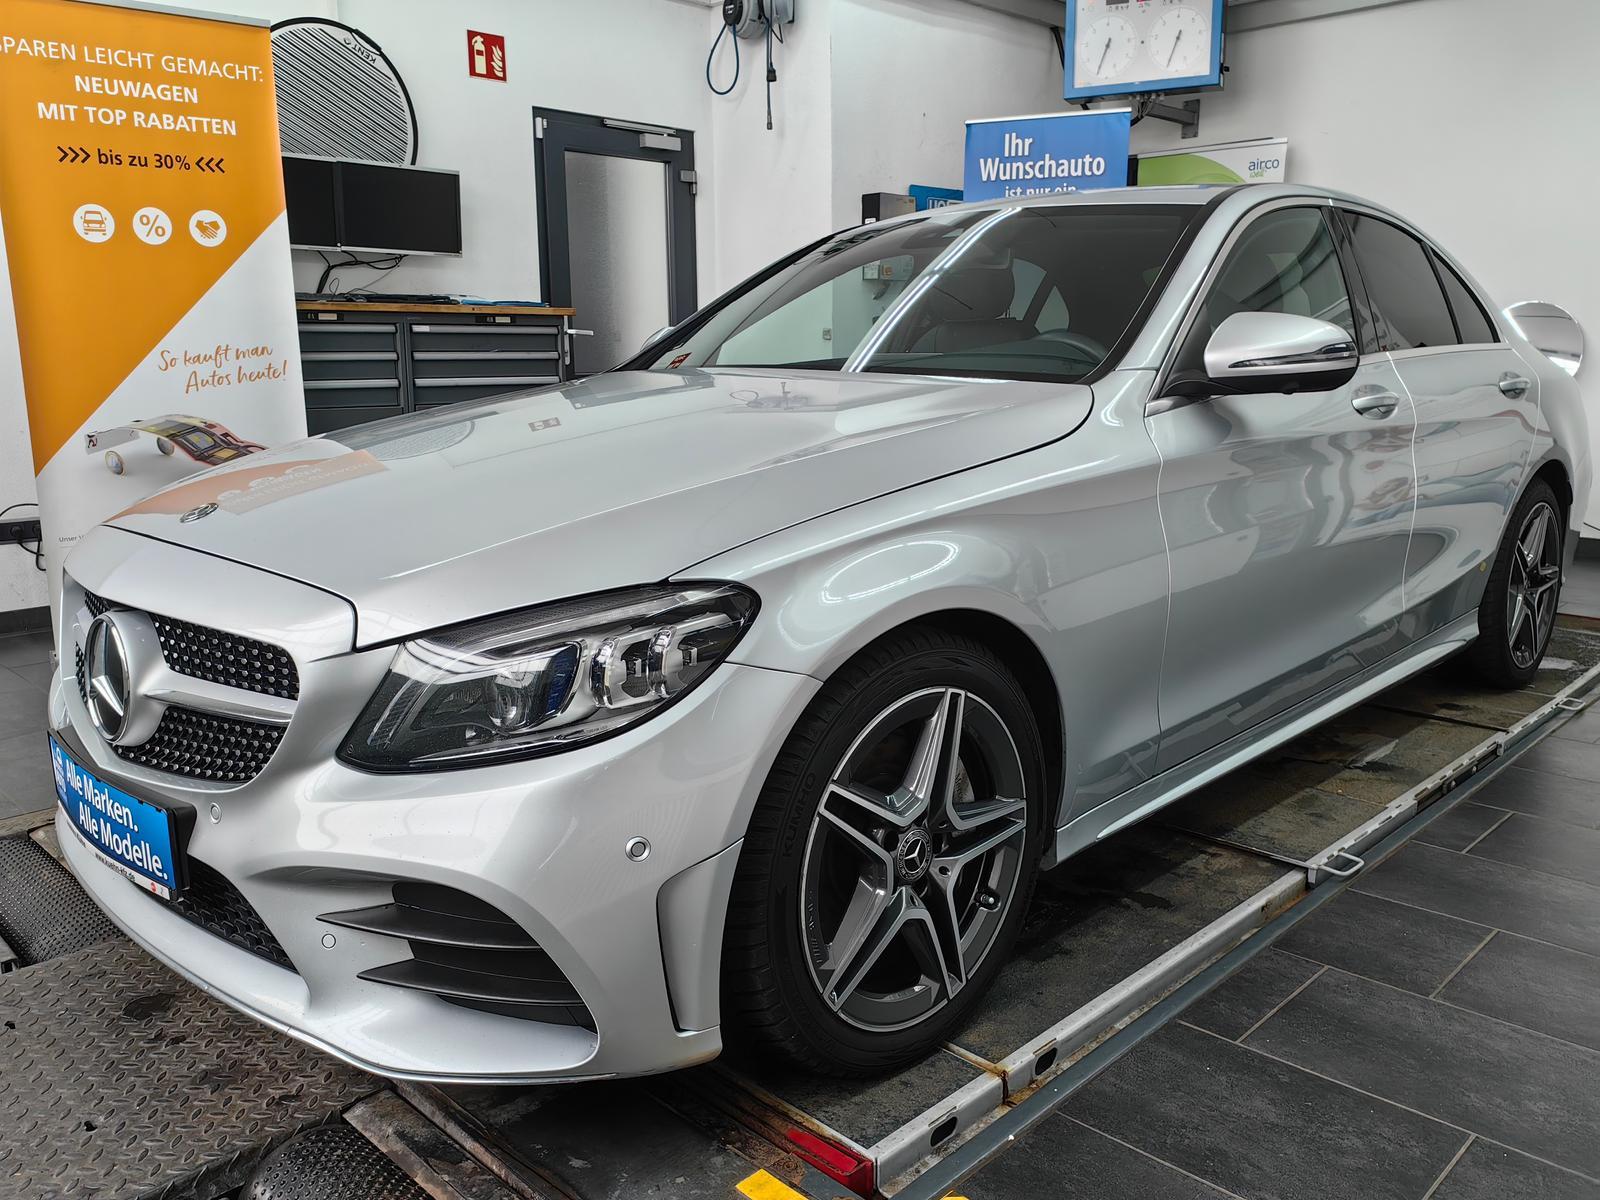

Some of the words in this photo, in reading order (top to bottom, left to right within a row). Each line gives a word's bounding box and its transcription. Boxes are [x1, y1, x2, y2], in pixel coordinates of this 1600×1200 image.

[84, 46, 154, 69] LEICHT
[161, 55, 264, 82] GEMACHT:
[352, 44, 377, 64] KENT
[75, 75, 198, 103] NEUWAGEN
[37, 102, 77, 121] MIT
[84, 106, 127, 126] TOP
[134, 112, 237, 136] RABATTEN
[1003, 132, 1034, 158] Ihr
[97, 148, 123, 166] bis
[128, 153, 148, 168] zu
[154, 154, 191, 171] 30%
[979, 154, 1106, 182] Wunschauto
[1248, 158, 1280, 171] airco
[158, 349, 178, 371] So
[183, 344, 232, 369] kauft
[235, 344, 273, 361] man
[185, 371, 231, 394] Autos
[237, 360, 288, 384] heute!
[66, 758, 84, 797] Alle
[84, 774, 140, 833] Marken.
[79, 801, 99, 839] Alle
[99, 818, 168, 880] Modelle.
